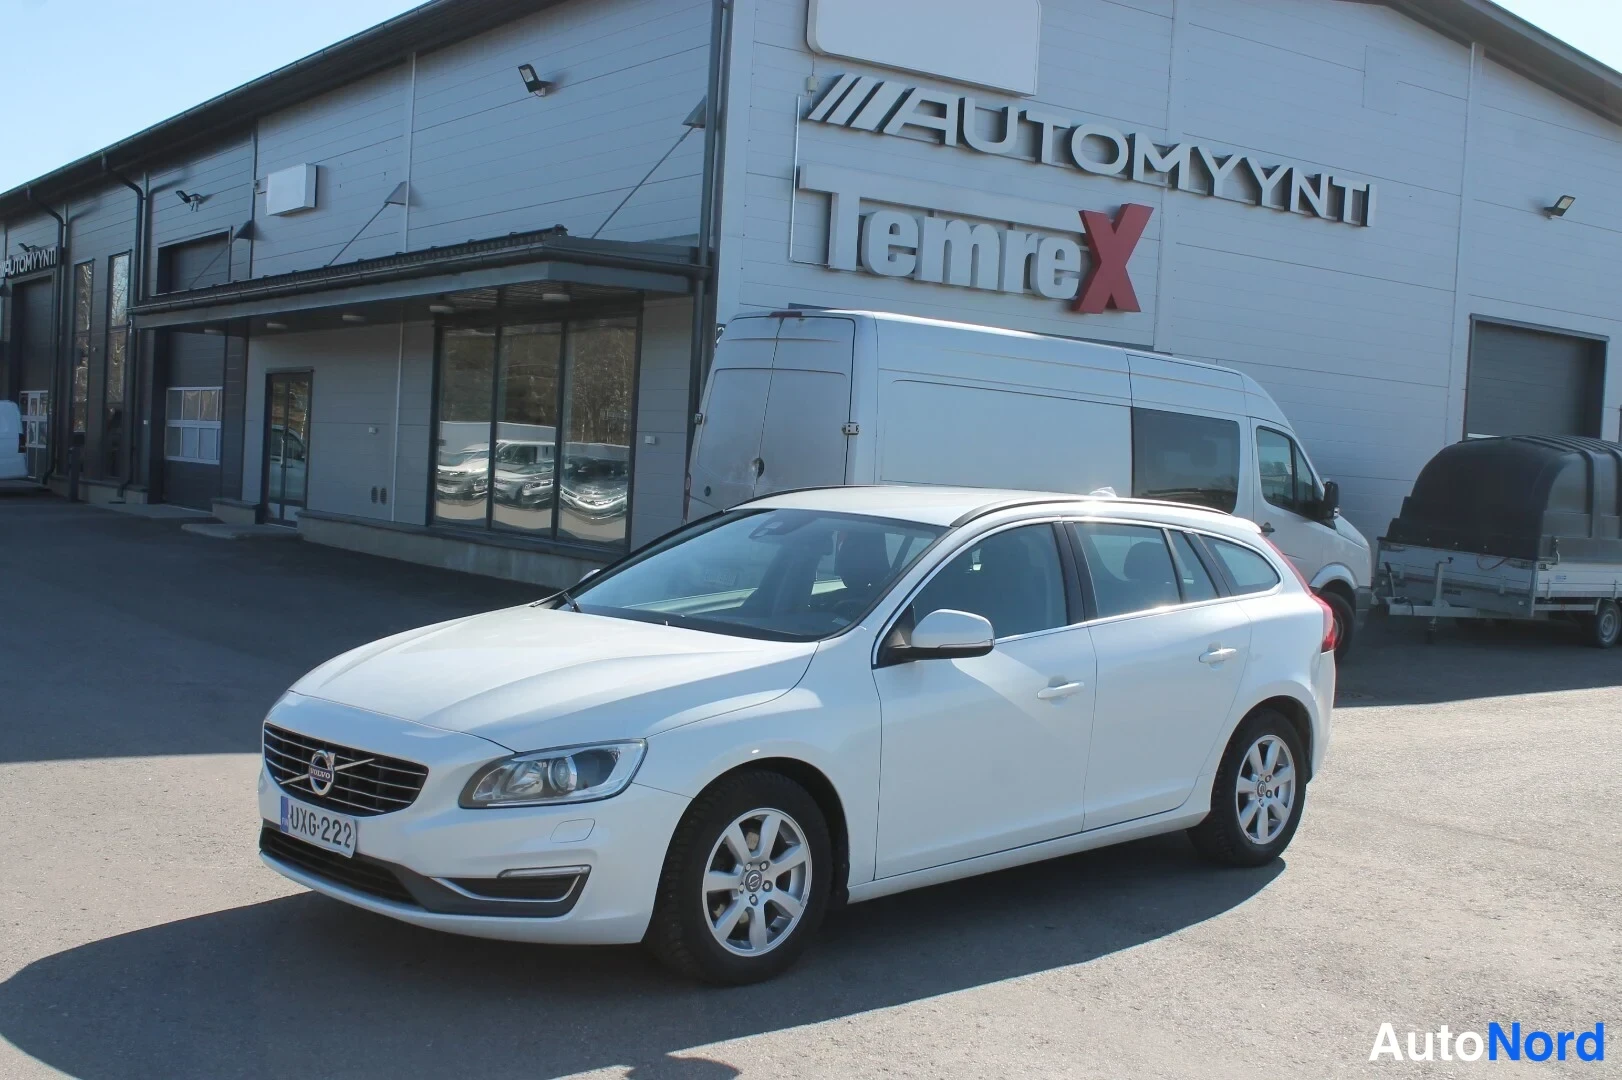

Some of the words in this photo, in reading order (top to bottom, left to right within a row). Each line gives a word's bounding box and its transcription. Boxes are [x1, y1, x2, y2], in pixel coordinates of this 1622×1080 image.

[882, 86, 1377, 227] AUTOMYYNTI
[799, 163, 1154, 314] TemreX
[310, 766, 331, 779] VOLVO
[290, 804, 352, 849] UXG-222
